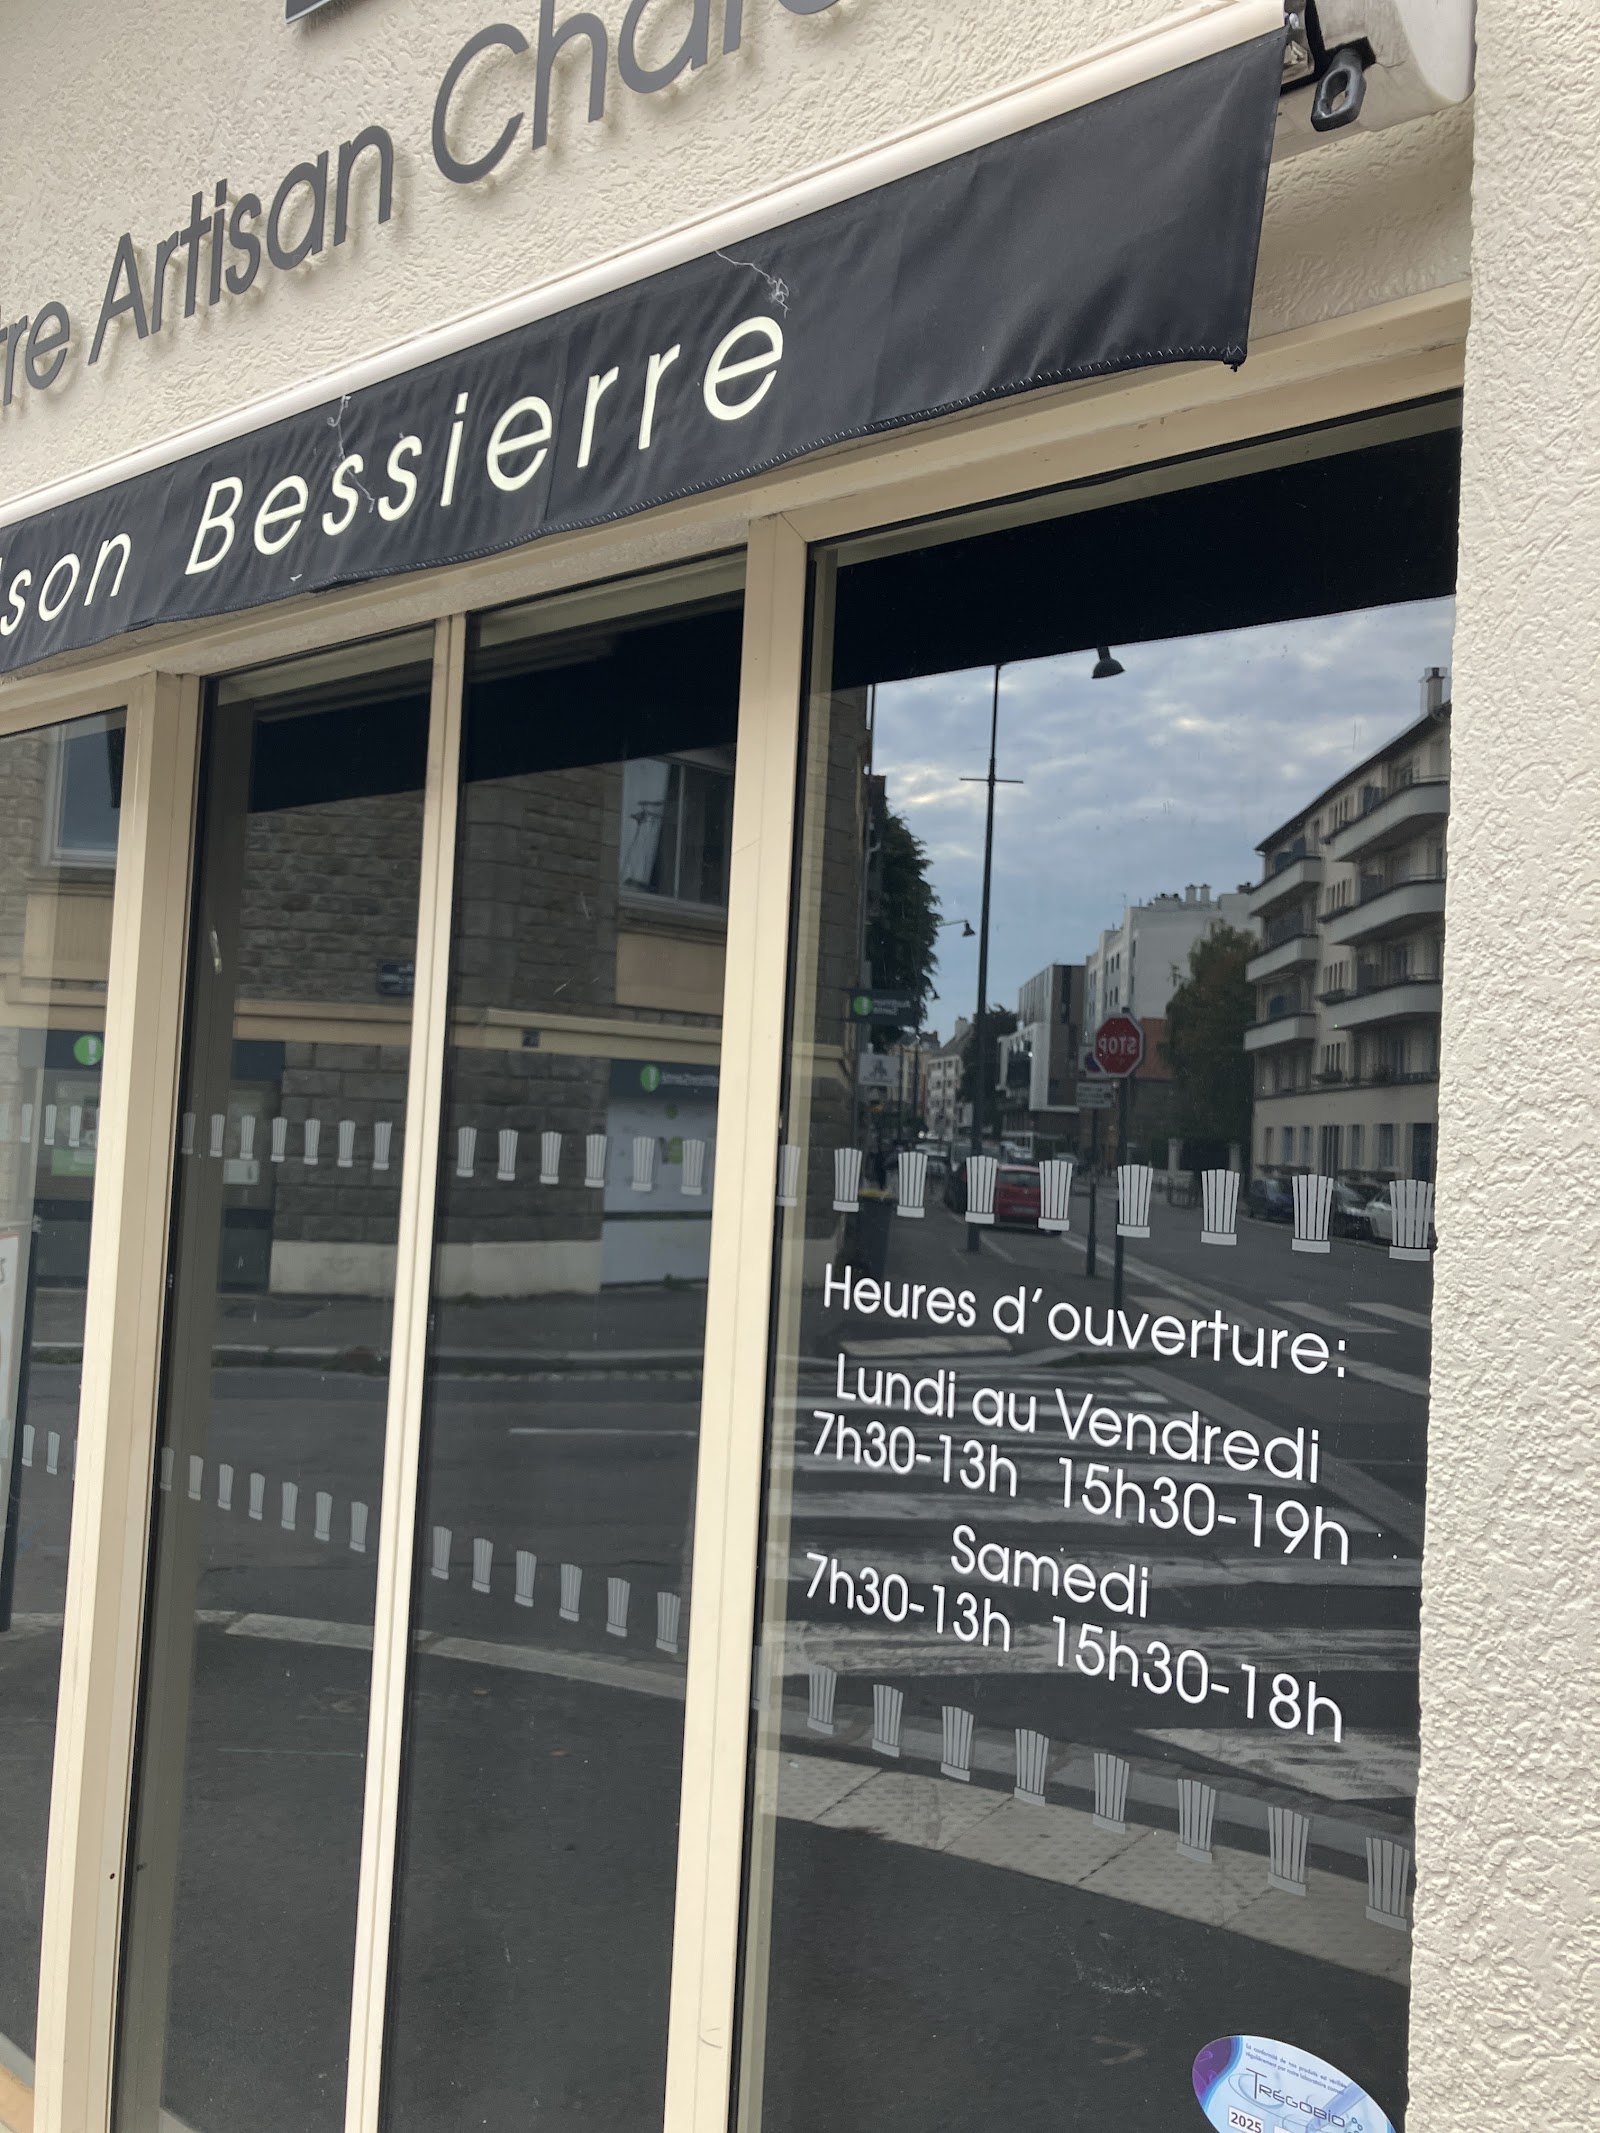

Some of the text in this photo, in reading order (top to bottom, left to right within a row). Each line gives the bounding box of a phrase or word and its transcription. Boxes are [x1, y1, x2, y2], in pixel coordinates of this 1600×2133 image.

[0, 0, 839, 406] re Artisan Cha
[0, 316, 784, 636] son Bessierre
[824, 1263, 977, 1328] Heures
[813, 1410, 1349, 1566] 7h30-13h 15h30-19h
[836, 1353, 1319, 1484] Lundi au Vendredi
[950, 1524, 1149, 1618] Samedi
[806, 1551, 1342, 1744] 7h30-13h 15h30-18h
[1231, 2111, 1262, 2133] 2025
